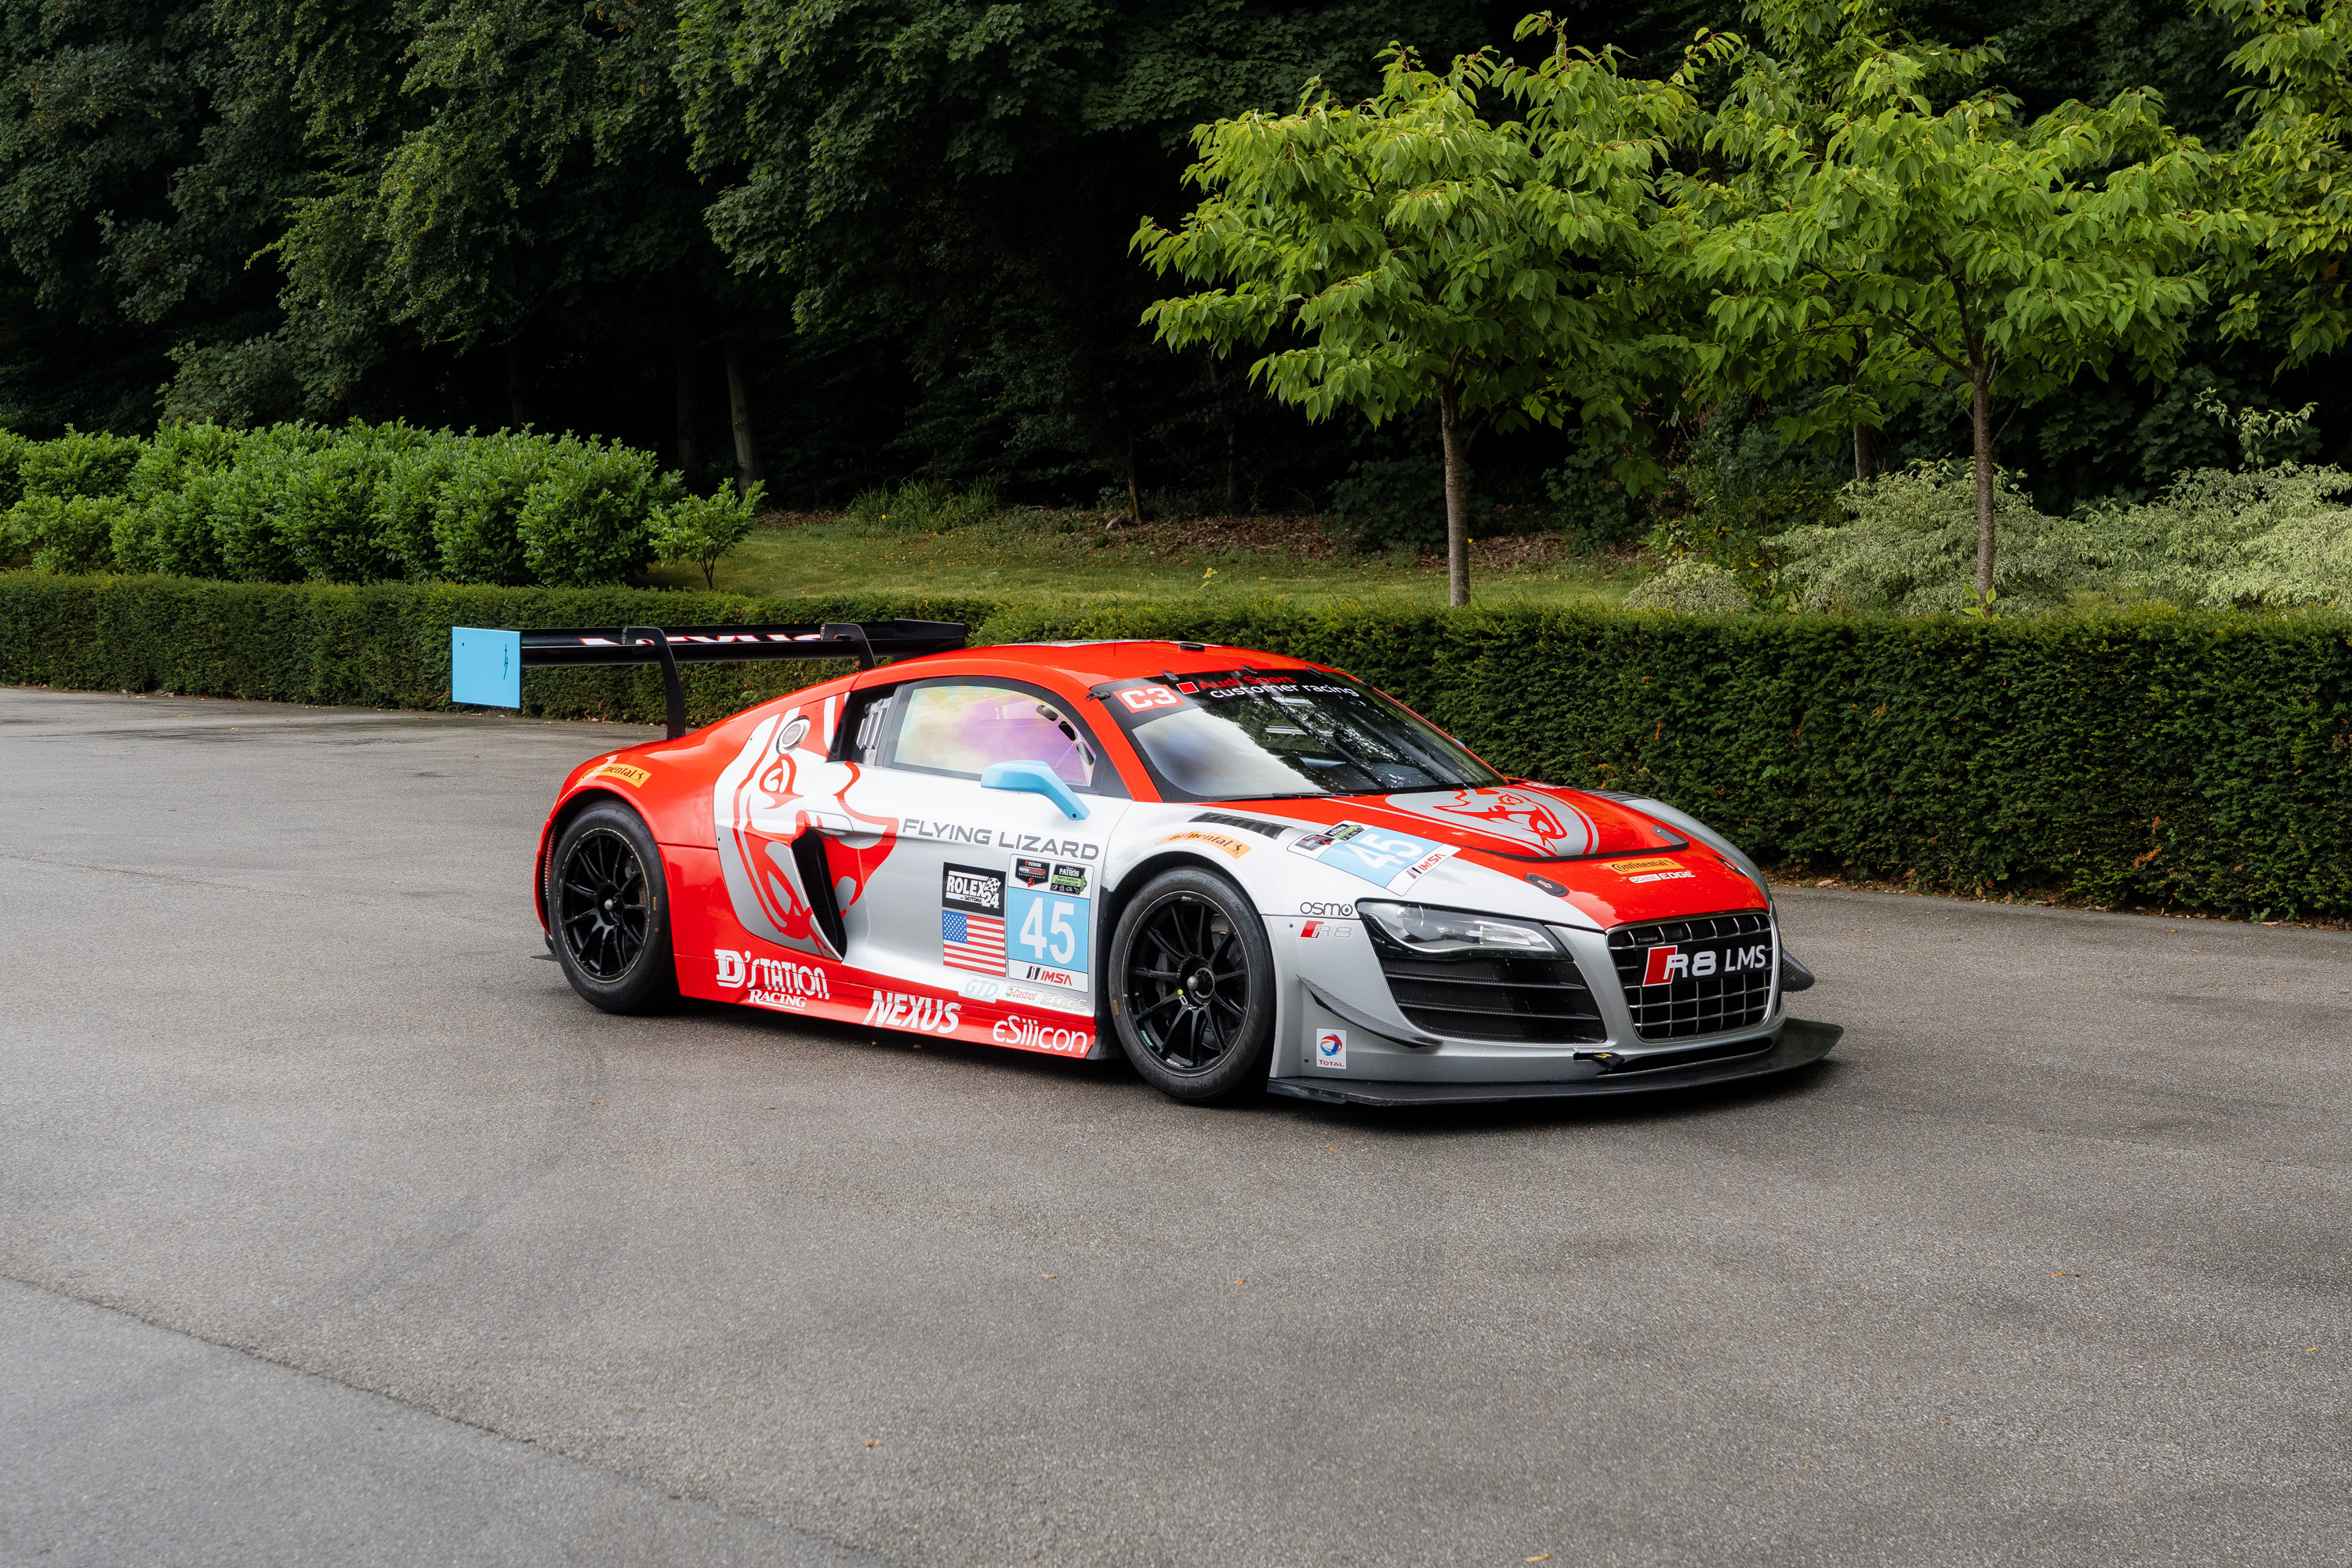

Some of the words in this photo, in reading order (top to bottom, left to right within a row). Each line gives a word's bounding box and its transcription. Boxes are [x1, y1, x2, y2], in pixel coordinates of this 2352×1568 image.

[1199, 677, 1244, 690] Audi
[1247, 675, 1298, 687] Sport
[1210, 684, 1299, 699] customer
[1301, 684, 1359, 697] racing
[1120, 687, 1177, 709] C3
[902, 818, 992, 845] FLYING
[998, 831, 1099, 861] LIZARD
[1343, 833, 1423, 869] 45
[1417, 853, 1446, 871] IMSA
[1611, 858, 1668, 872] Continental
[1058, 868, 1080, 877] PATRÓN
[1658, 871, 1696, 880] EDGE
[946, 875, 987, 898] ROLEX
[981, 891, 1000, 909] 24
[1019, 897, 1076, 964] 45
[1311, 924, 1354, 939] R8
[1662, 949, 1717, 981] R8
[1724, 944, 1766, 972] LMS
[1040, 970, 1073, 986] IMSA
[964, 978, 1000, 998] GTD
[747, 989, 808, 1008] RACING
[1012, 987, 1039, 1001] Castrol
[1040, 992, 1089, 1012] EDGE
[862, 990, 962, 1034] NEXUS
[992, 1014, 1088, 1054] eSilicon
[1318, 1059, 1345, 1068] TOTAL
